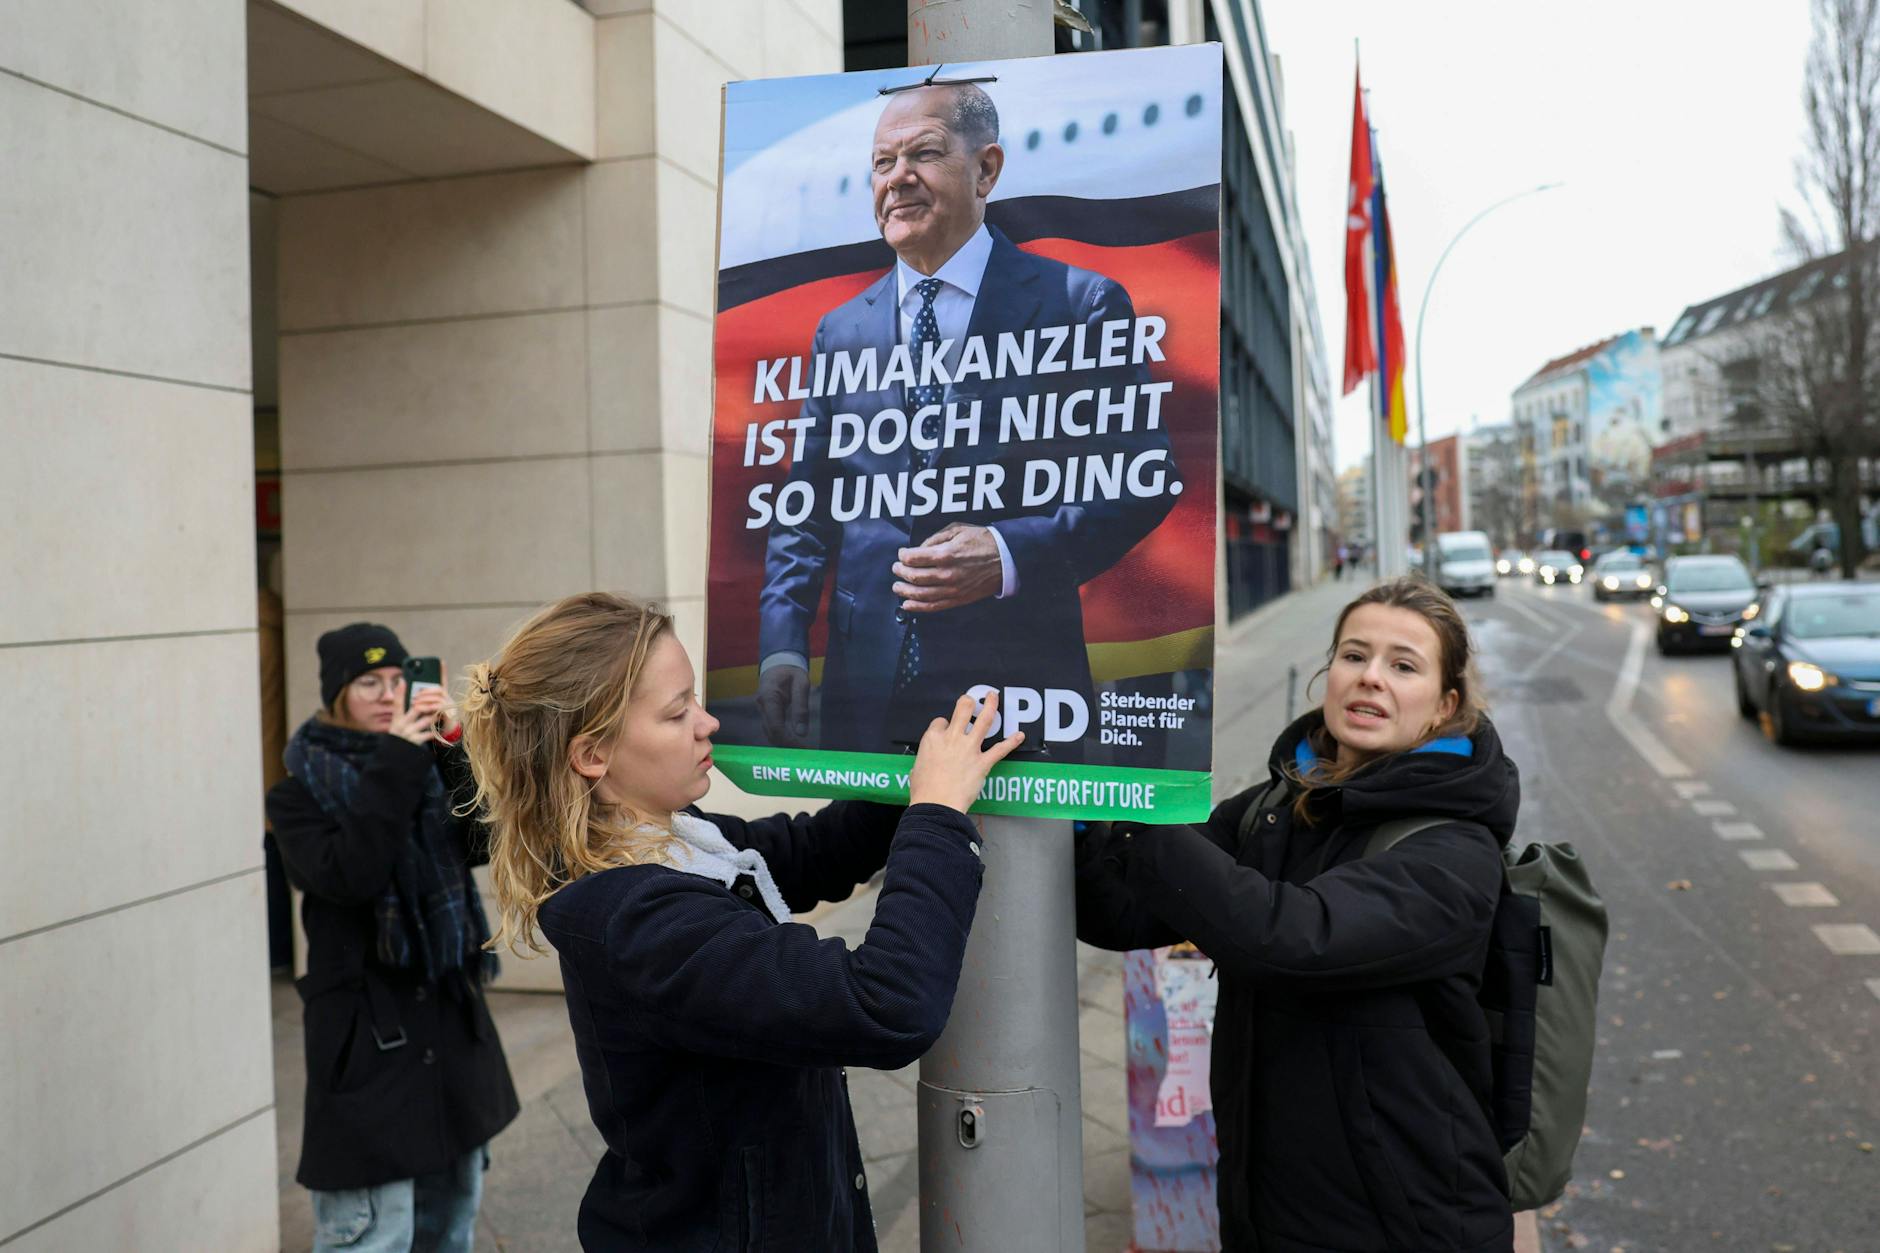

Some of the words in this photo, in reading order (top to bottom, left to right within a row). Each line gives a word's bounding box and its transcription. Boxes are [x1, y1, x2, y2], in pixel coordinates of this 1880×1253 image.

[753, 315, 1167, 404] KLIMAKANZLER
[743, 416, 817, 467] IST
[827, 402, 982, 460] DOCH
[998, 382, 1174, 442] NICHT
[745, 480, 815, 530] SO
[829, 463, 1005, 523] UNSER
[1021, 449, 1185, 507] DING.
[1101, 692, 1195, 710] Sterbender
[1100, 710, 1155, 729] Planet
[1157, 711, 1185, 730] für
[1100, 728, 1143, 747] Dich.
[753, 766, 790, 781] EINE
[796, 768, 890, 788] WARNUNG
